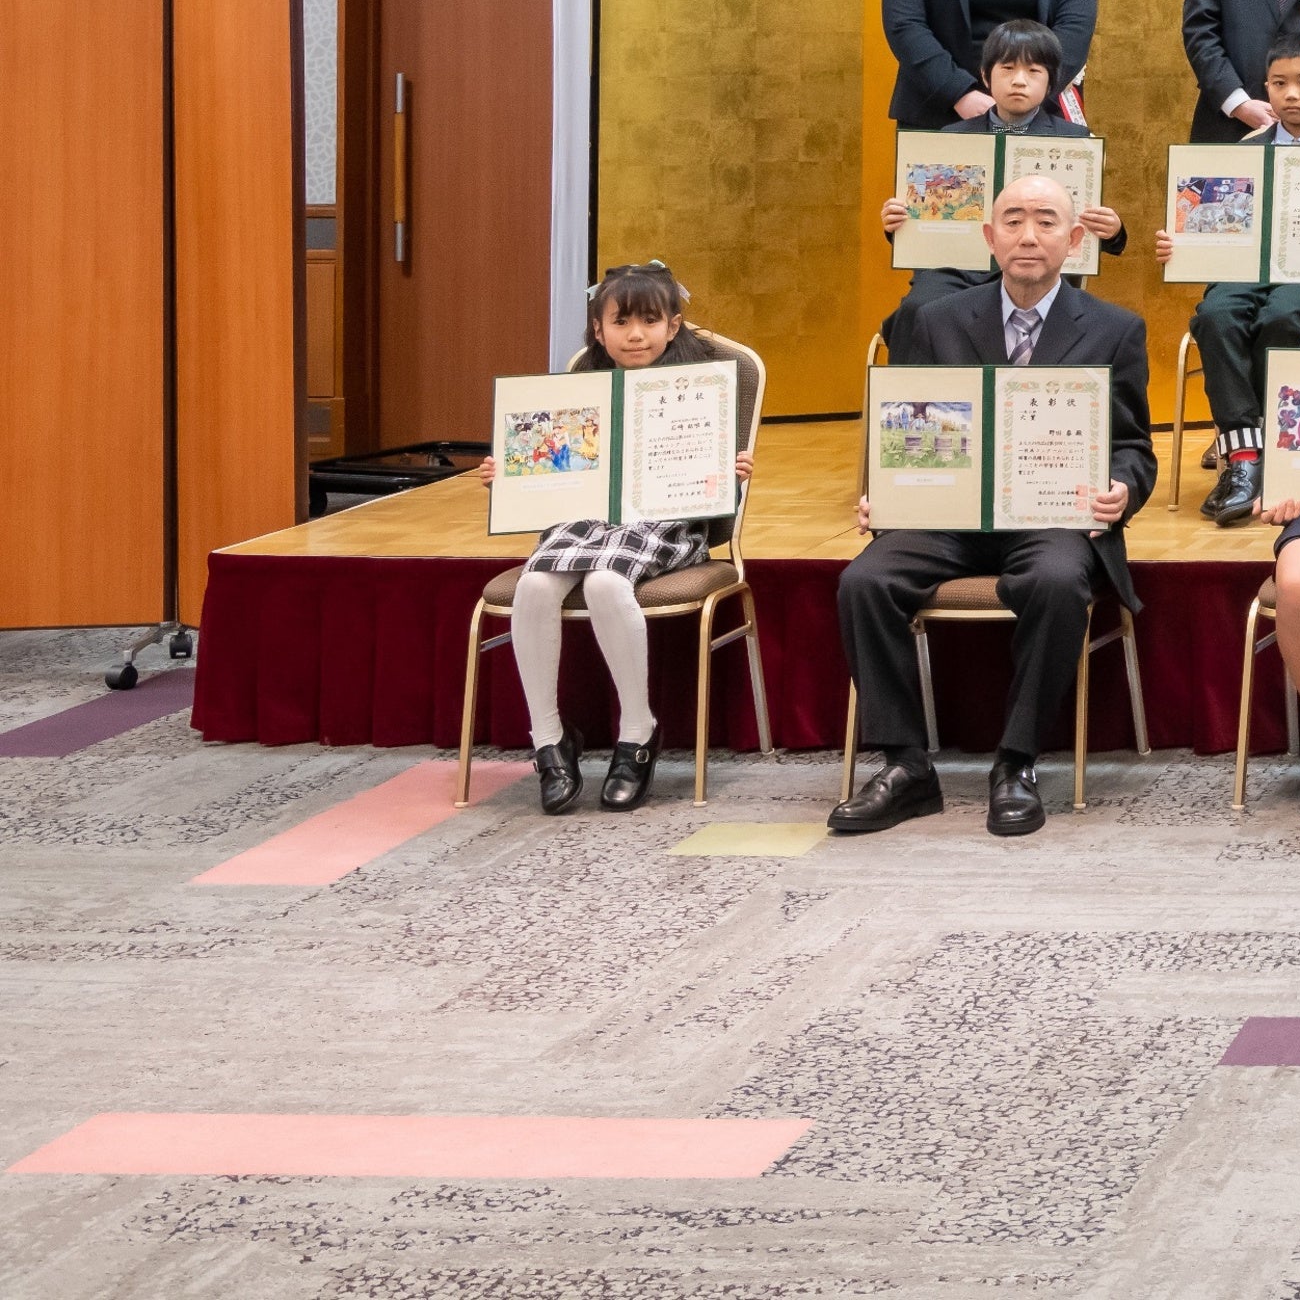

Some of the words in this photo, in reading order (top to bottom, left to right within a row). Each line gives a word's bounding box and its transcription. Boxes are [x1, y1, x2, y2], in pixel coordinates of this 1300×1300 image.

[658, 391, 705, 405] 表彰状
[1029, 398, 1077, 407] 表彰状
